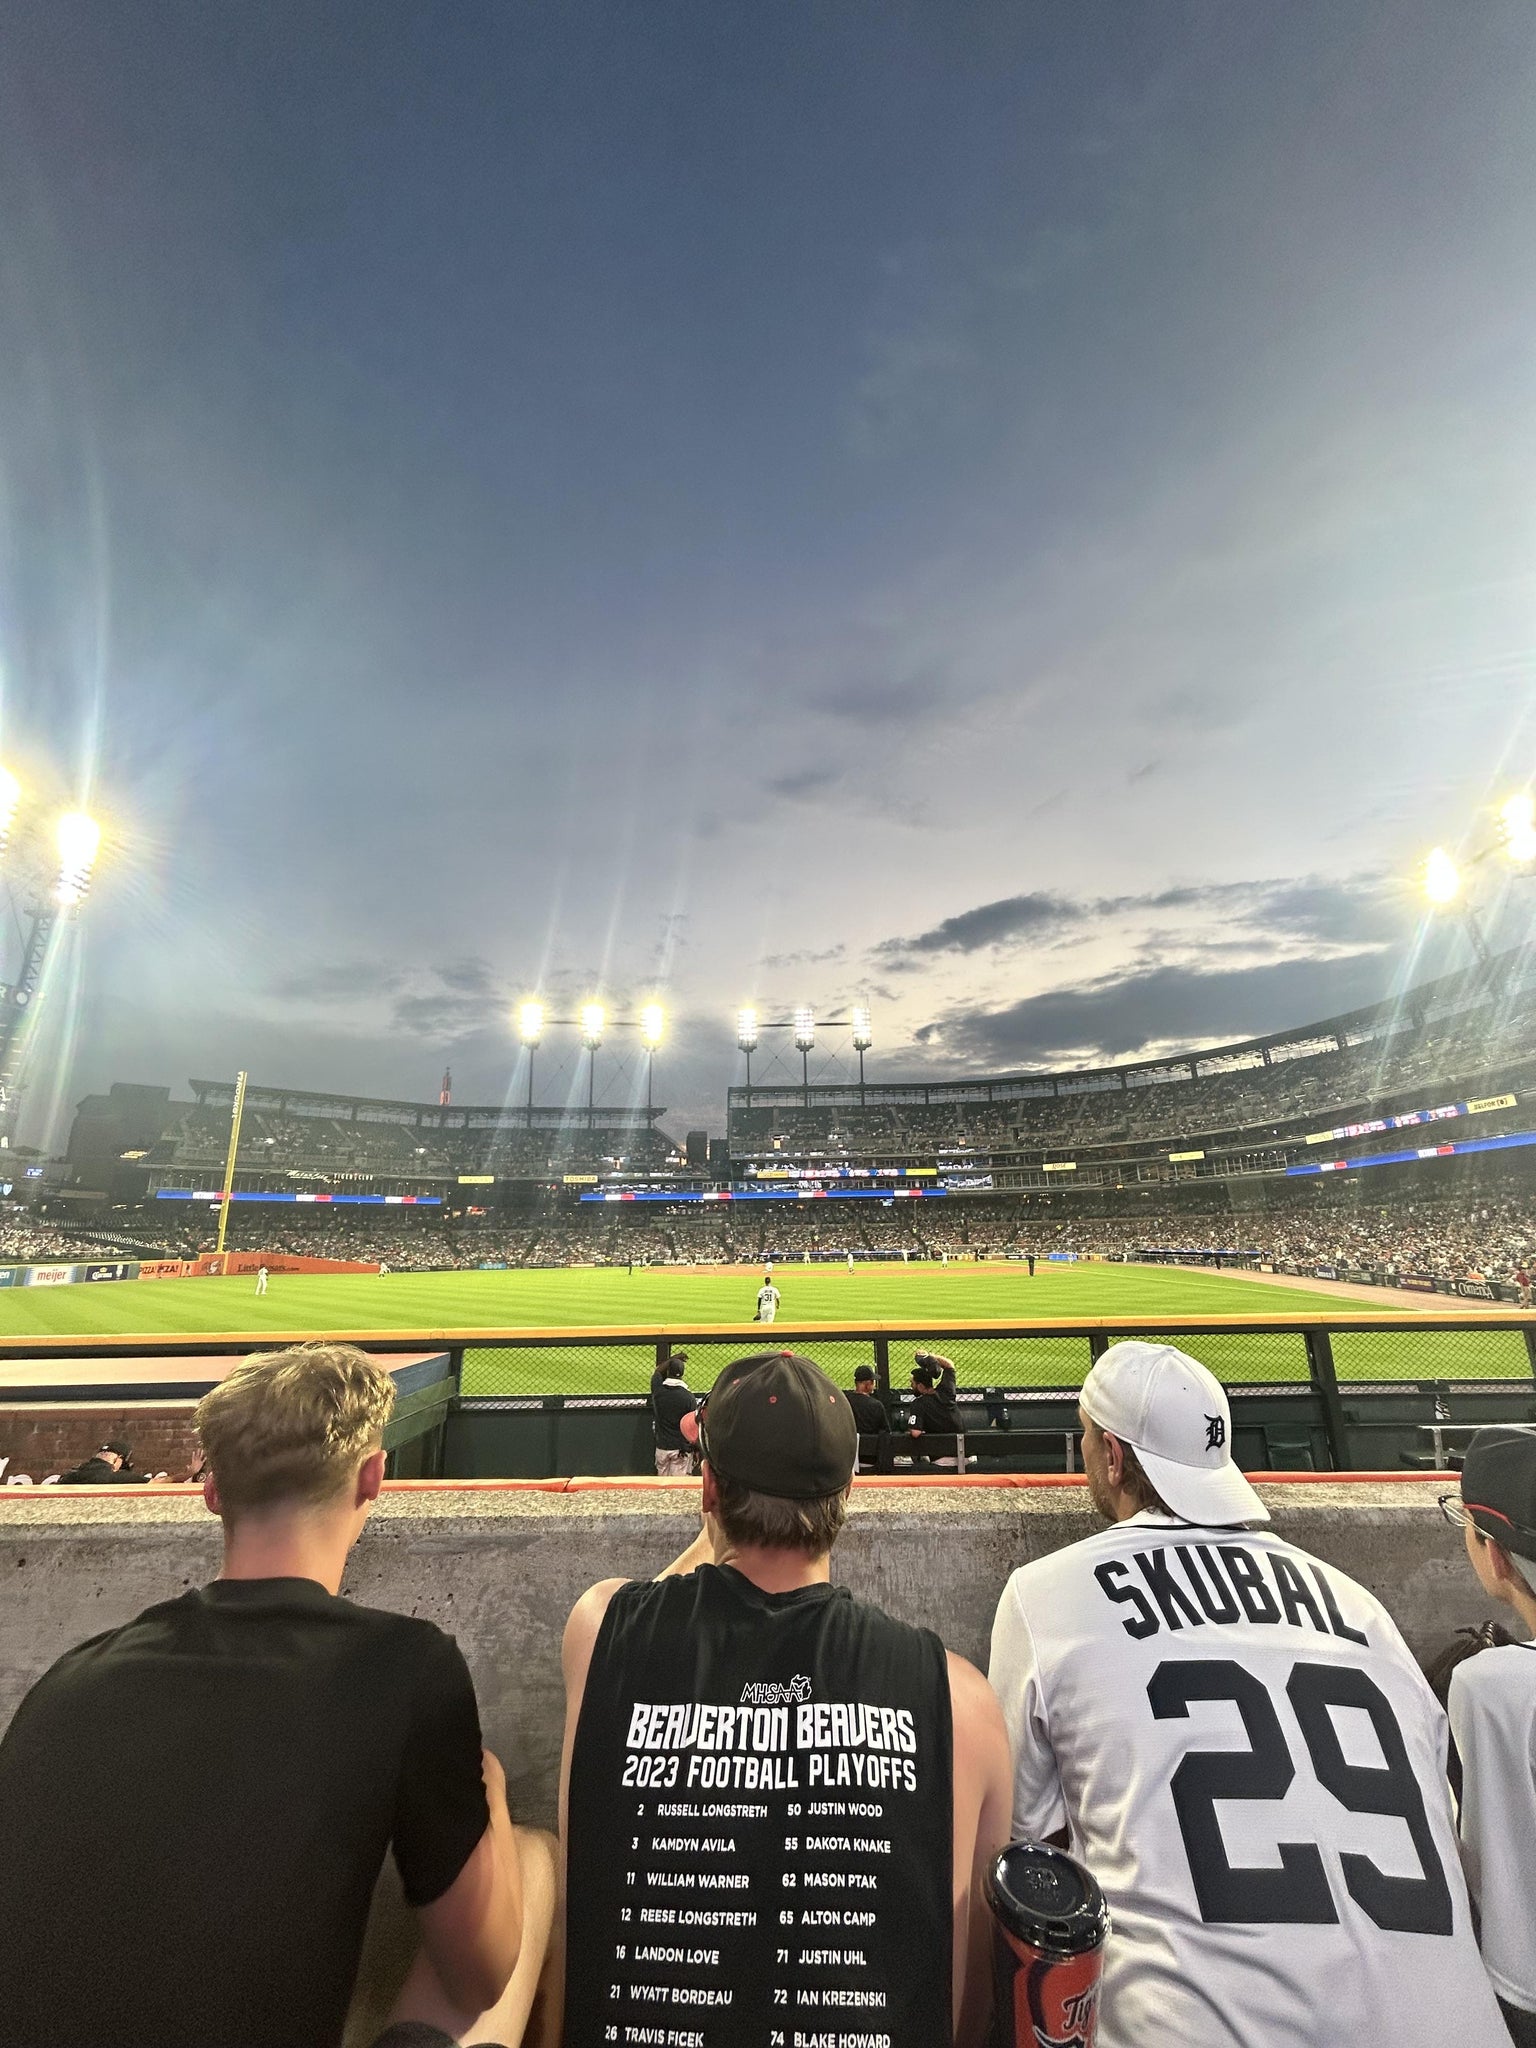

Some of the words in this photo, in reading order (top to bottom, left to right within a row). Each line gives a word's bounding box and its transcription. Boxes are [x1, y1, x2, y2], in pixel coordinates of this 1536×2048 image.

[37, 1269, 67, 1282] meijer
[764, 1293, 772, 1302] 31
[1093, 1545, 1370, 1648] SKUBAL
[739, 1682, 803, 1704] MHSAA
[625, 1702, 789, 1752] BEAVERTON
[796, 1702, 917, 1754] BEAVERS
[621, 1754, 680, 1788] 2023
[686, 1754, 799, 1791] FOOTBALL
[808, 1752, 917, 1792] PLAYOFFS
[1146, 1660, 1455, 1937] 29
[636, 1803, 645, 1817] 2
[657, 1803, 700, 1817] RUSSELL
[701, 1803, 768, 1818] LONGSTRETH
[787, 1803, 802, 1817] 50
[807, 1802, 846, 1816] JUSTIN
[847, 1802, 883, 1818] WOOD
[631, 1836, 639, 1850] 3
[651, 1837, 700, 1852] KAMDYN
[700, 1838, 736, 1853] AVILA
[784, 1836, 799, 1851] 55
[805, 1836, 852, 1851] DAKOTA
[853, 1837, 891, 1854] KNAKE
[626, 1871, 636, 1885] 11
[646, 1872, 696, 1888] WILLIAM
[698, 1874, 750, 1889] WARNER
[781, 1872, 797, 1888] 62
[803, 1872, 846, 1888] MASON
[847, 1873, 878, 1890] PTAK
[621, 1907, 632, 1922] 12
[639, 1908, 677, 1924] REESE
[678, 1909, 757, 1927] LONGSTRETH
[779, 1910, 794, 1925] 65
[801, 1910, 841, 1926] ALTON
[843, 1911, 876, 1927] CAMP
[615, 1945, 626, 1960] 16
[634, 1945, 684, 1963] LANDON
[686, 1948, 720, 1965] LOVE
[776, 1948, 789, 1964] 71
[798, 1949, 841, 1965] JUSTIN
[843, 1950, 867, 1966] UHL
[609, 1984, 621, 1999] 21
[630, 1984, 670, 2003] WYATT
[671, 1987, 733, 2006] BORDEAU
[773, 1988, 788, 2005] 72
[796, 1989, 819, 2006] IAN
[822, 1990, 887, 2008] KREZENSKI
[604, 2025, 618, 2041] 26
[624, 2026, 665, 2045] TRAVIS
[667, 2030, 704, 2048] FICEK
[770, 2030, 785, 2047] 74
[793, 2031, 836, 2048] BLAKE
[838, 2033, 891, 2048] HOWARD
